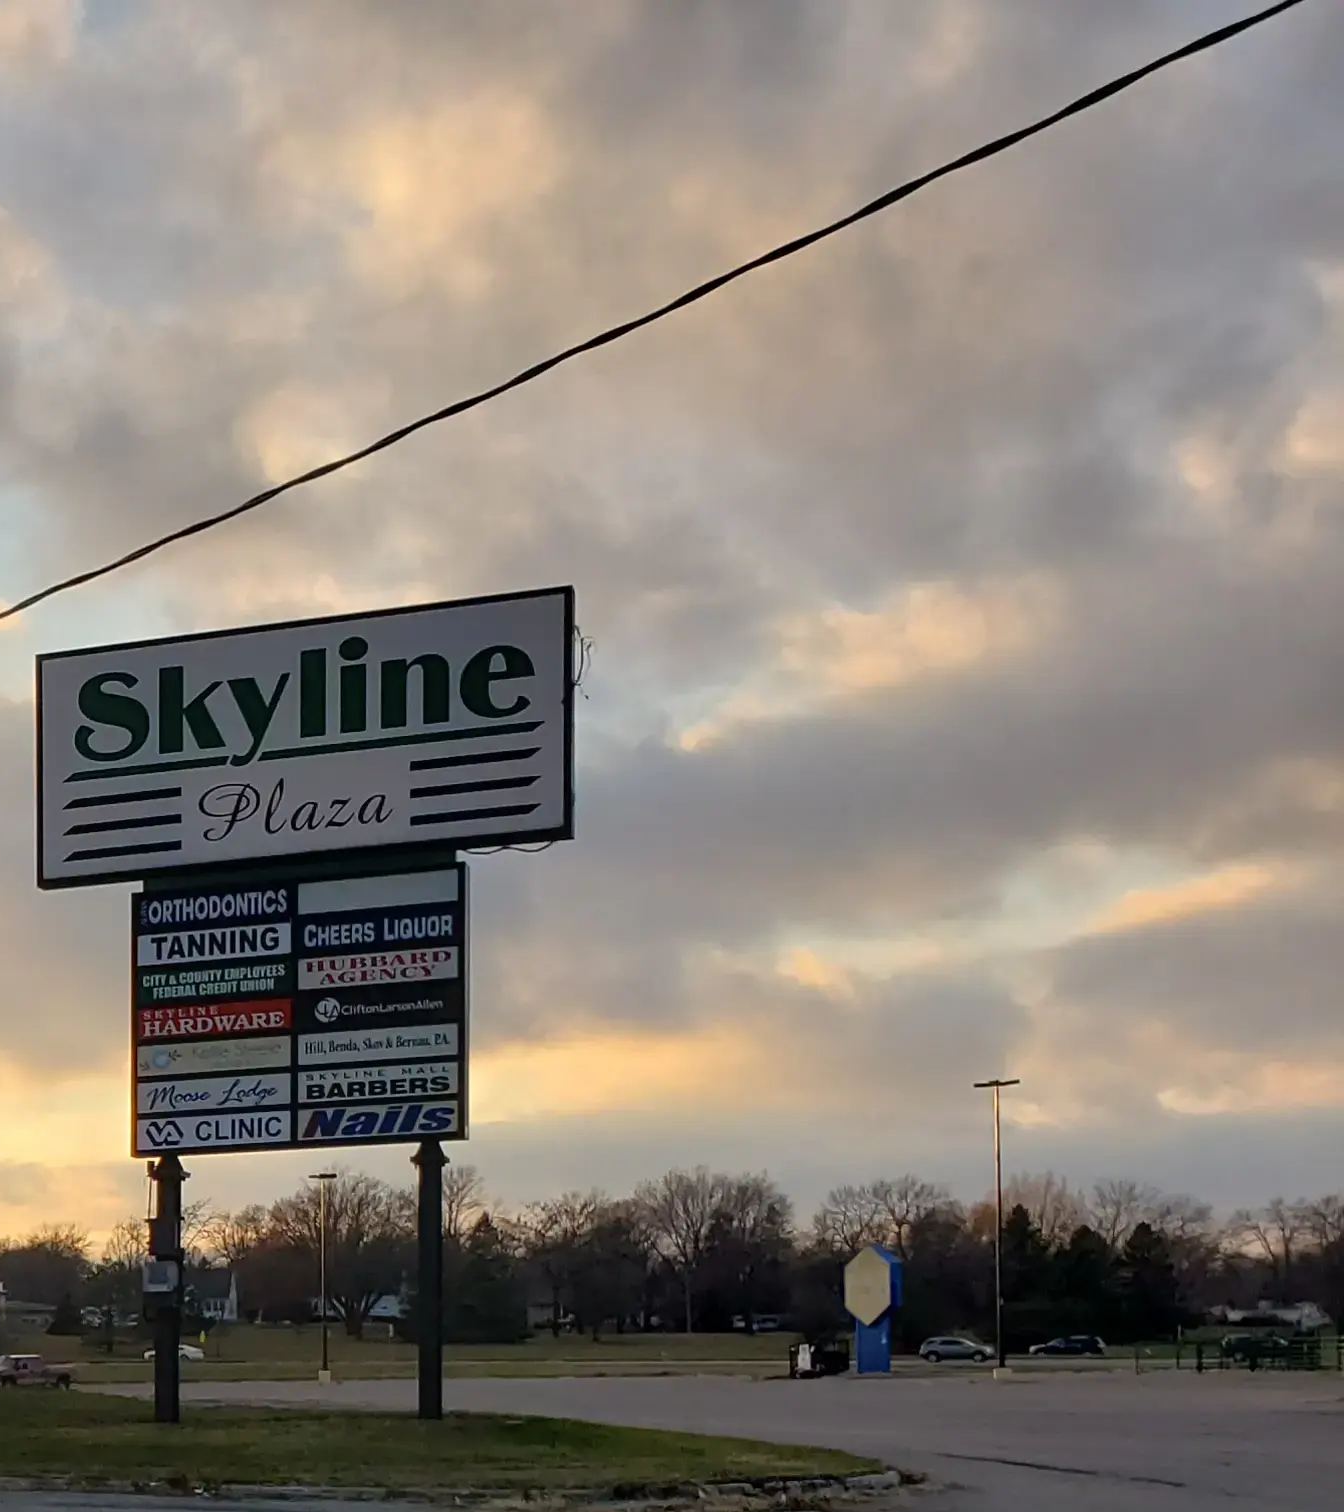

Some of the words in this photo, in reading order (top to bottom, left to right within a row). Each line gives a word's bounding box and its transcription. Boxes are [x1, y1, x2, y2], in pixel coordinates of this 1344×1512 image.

[74, 636, 535, 766] Skyline
[198, 778, 392, 841] Plaza
[148, 889, 288, 924] ORTHODONTICS
[304, 922, 375, 947] CHEERS
[384, 915, 453, 941] LIQUOR
[151, 927, 279, 960] TANNING
[306, 951, 451, 972] HUBBARD
[143, 974, 166, 987] CITY
[179, 969, 222, 984] COUNTY
[224, 964, 285, 980] EMPLOYEES
[320, 966, 433, 985] AGENCY
[153, 985, 197, 1000] FEDERAL
[199, 981, 238, 996] CREDIT
[240, 978, 275, 992] UNION
[144, 1006, 218, 1020] SKYLINE
[341, 999, 444, 1016] CliftonLarsonAllen
[144, 1012, 284, 1037] HARDWARE
[305, 1040, 327, 1056] Hill,
[385, 1036, 393, 1049] &
[306, 1069, 387, 1081] SKYLINE
[401, 1065, 450, 1076] MALL
[146, 1085, 211, 1110] Moose
[216, 1079, 279, 1106] Lodge
[306, 1076, 450, 1100] BARBERS
[195, 1117, 282, 1142] CLINIC
[302, 1104, 455, 1138] Nails
